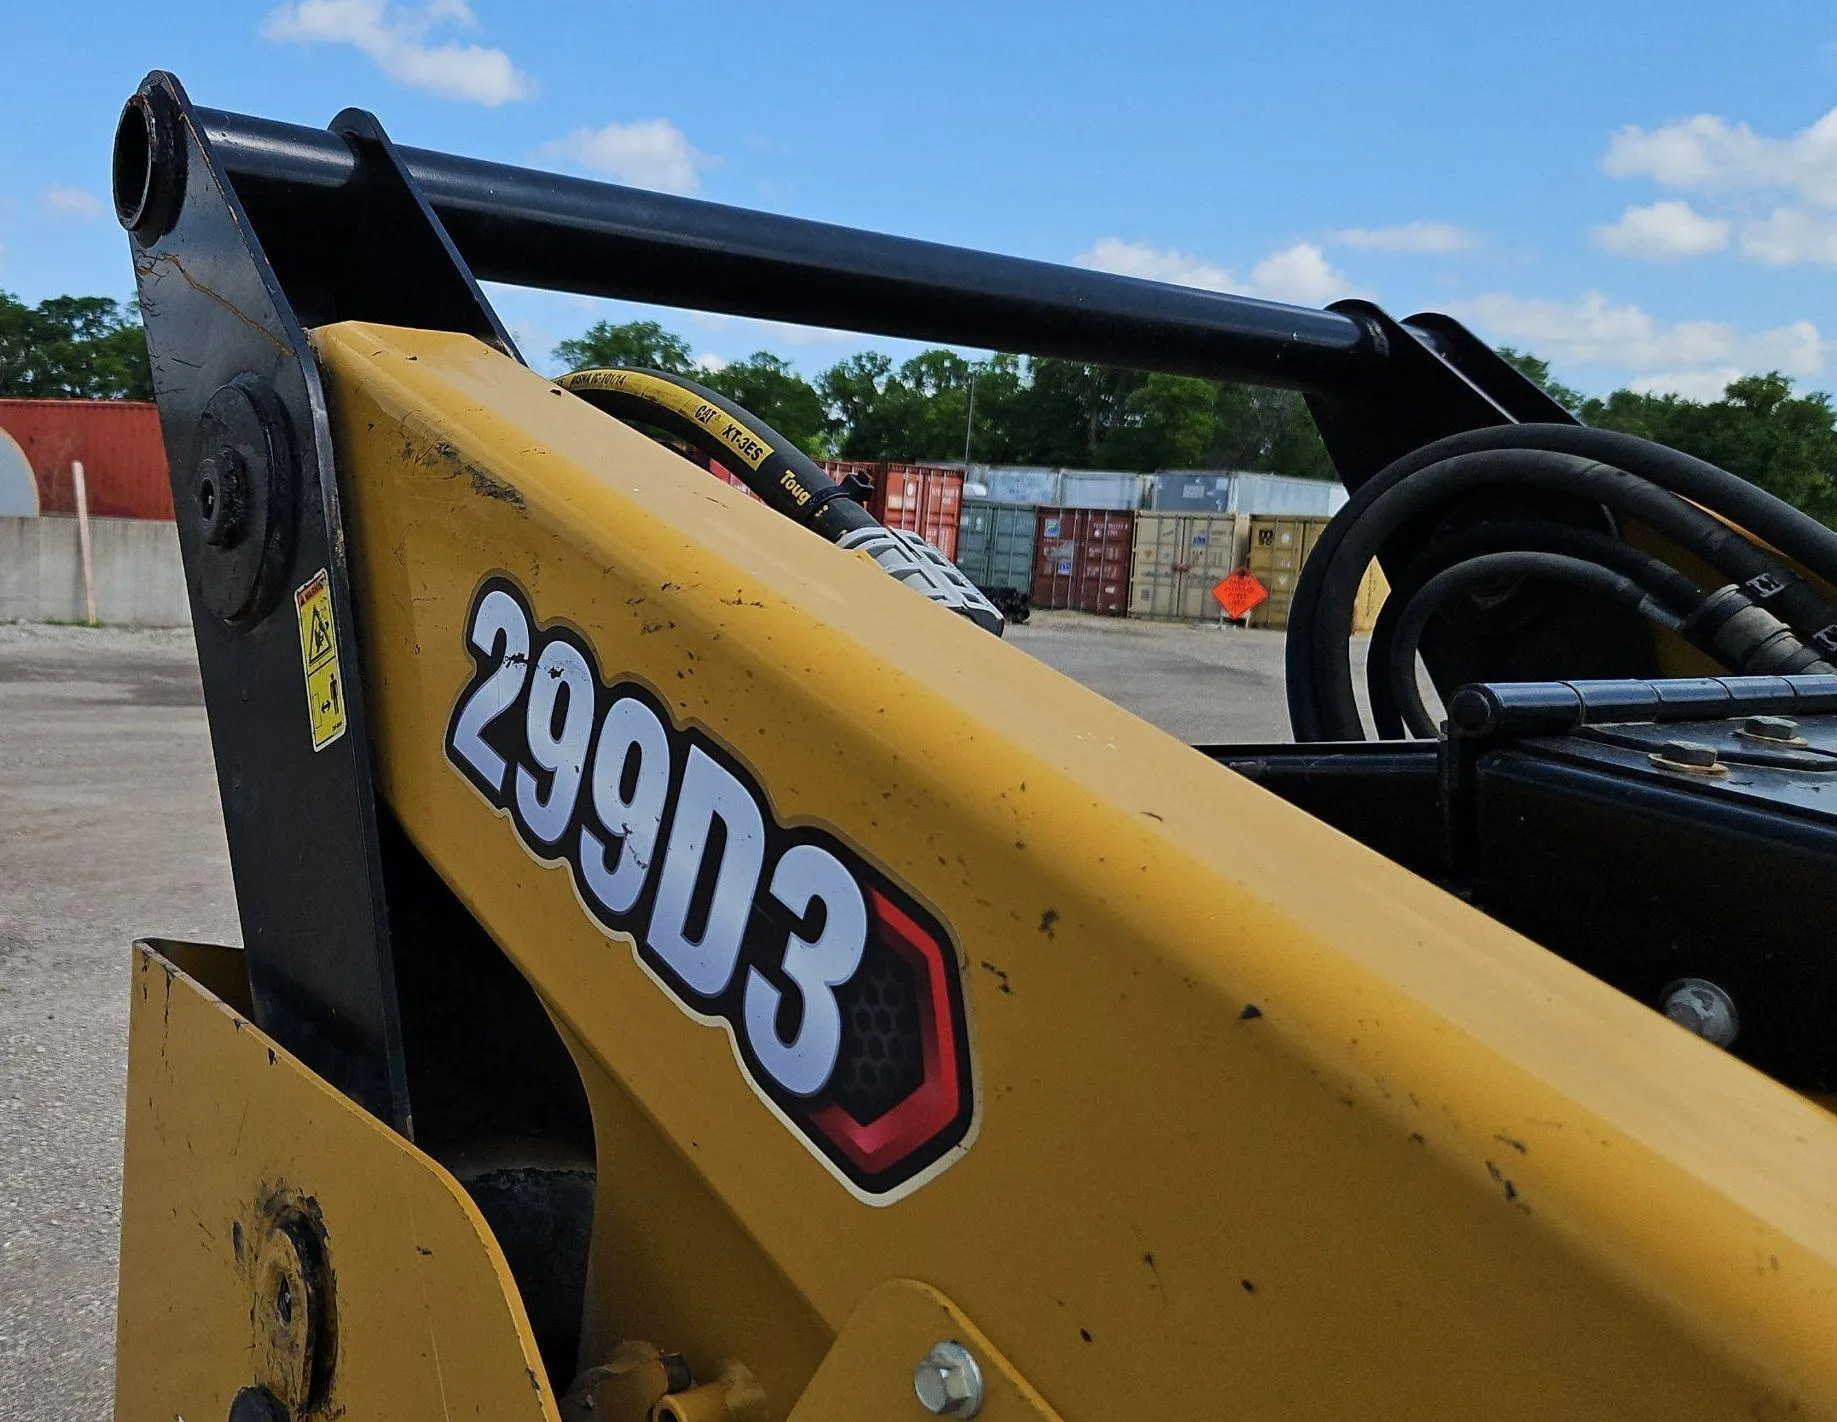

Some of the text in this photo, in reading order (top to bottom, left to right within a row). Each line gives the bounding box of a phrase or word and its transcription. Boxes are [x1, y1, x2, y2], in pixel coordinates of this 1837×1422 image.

[721, 424, 763, 461] XT-3ES
[779, 469, 812, 506] Toug
[453, 590, 867, 1095] 299D3
